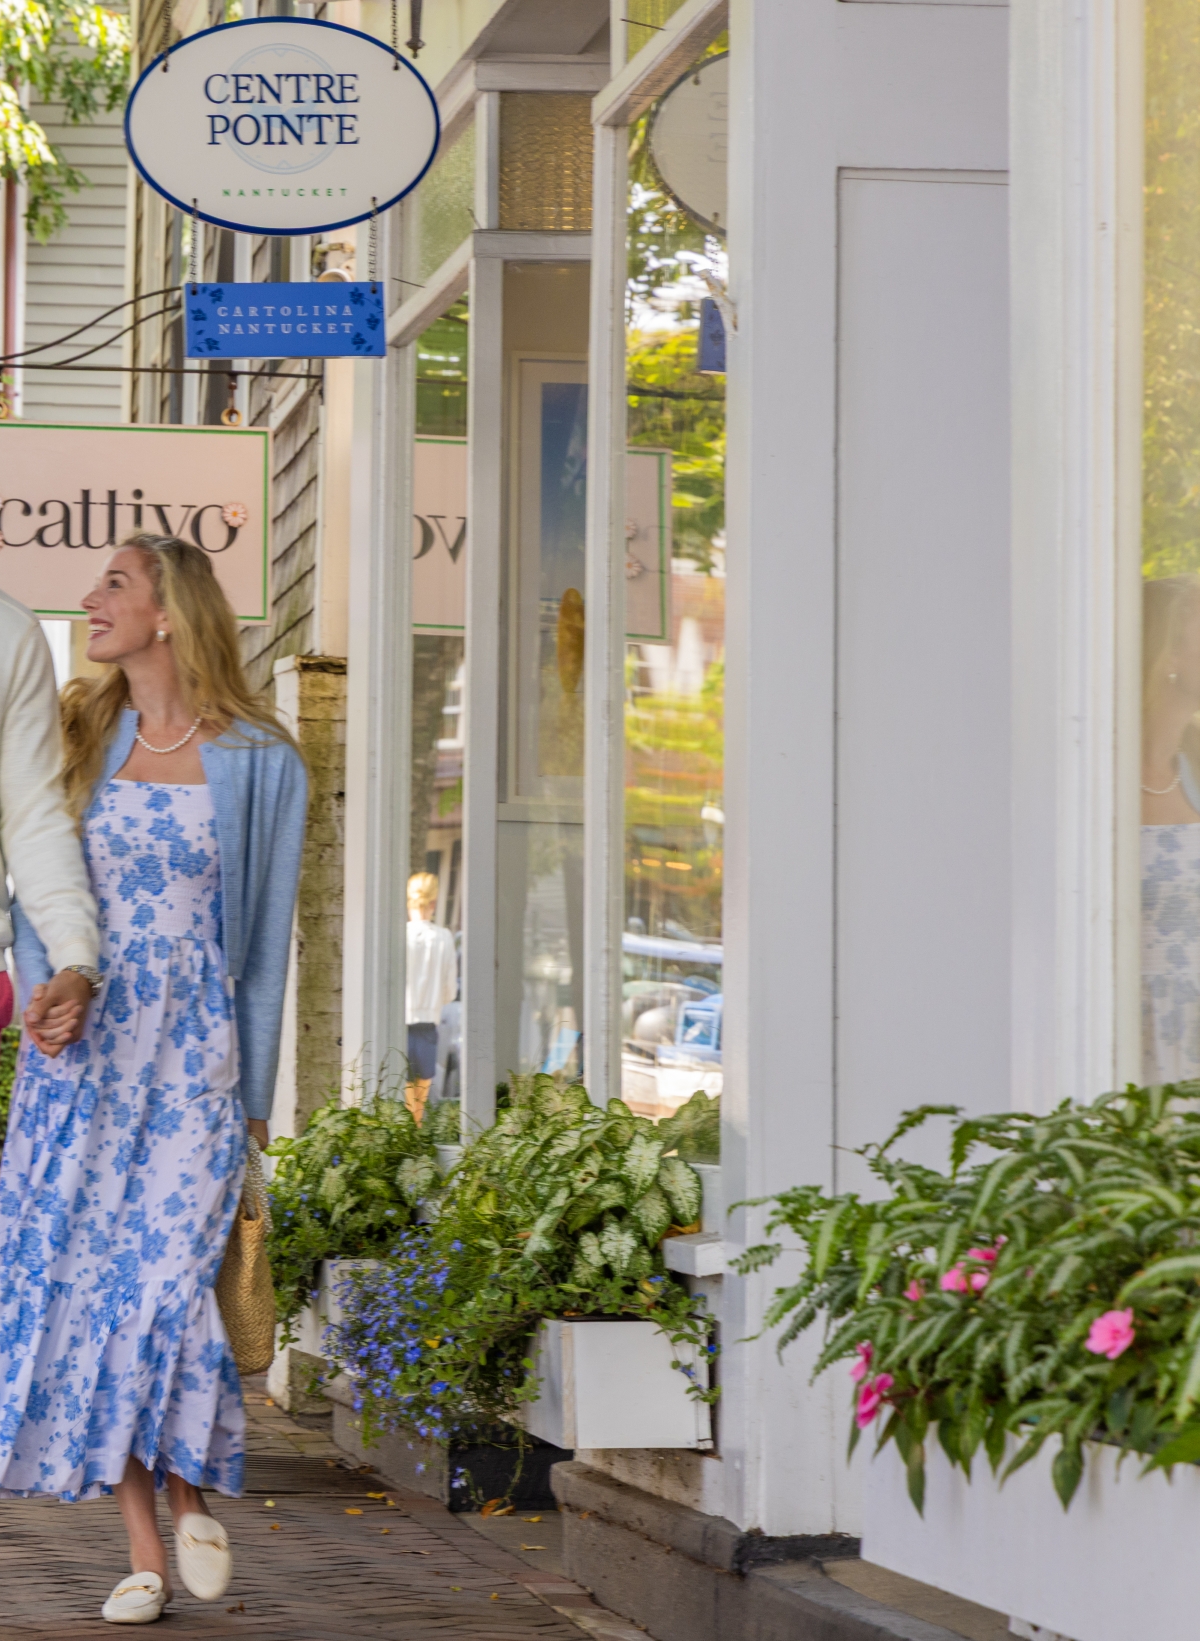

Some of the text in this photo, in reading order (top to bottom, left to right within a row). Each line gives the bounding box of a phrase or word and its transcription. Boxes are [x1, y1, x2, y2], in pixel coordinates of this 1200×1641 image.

[204, 74, 360, 104] CENTRE
[207, 114, 360, 145] POINTE
[222, 188, 348, 197] NANTUCKET
[216, 305, 354, 317] CARTOLINA
[218, 323, 354, 335] NANTUCKET
